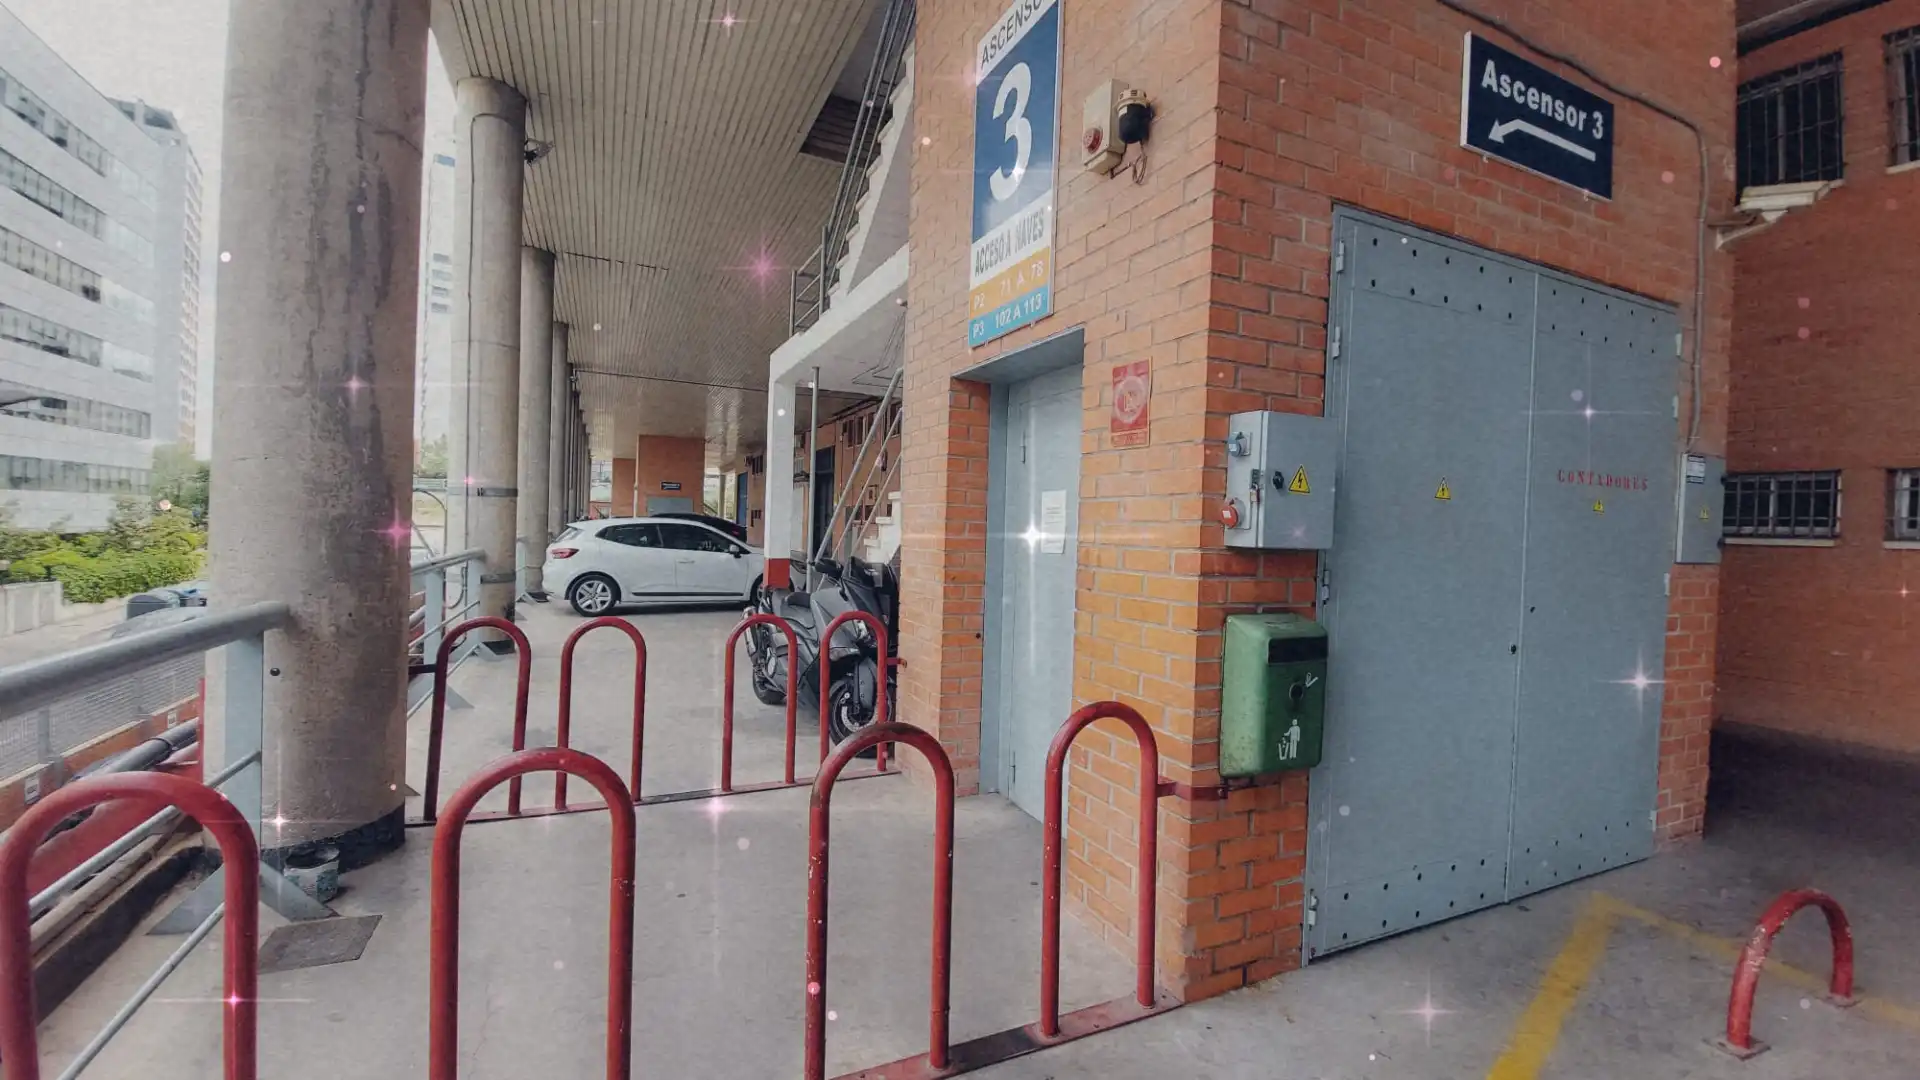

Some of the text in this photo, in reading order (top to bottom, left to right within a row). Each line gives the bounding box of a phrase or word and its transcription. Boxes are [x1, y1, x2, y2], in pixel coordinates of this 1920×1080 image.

[1481, 59, 1604, 140] Ascensor 3
[991, 62, 1032, 200] 3
[975, 208, 1044, 277] ACCESO A NAVES
[973, 293, 1042, 338] P3 102 A 113
[974, 293, 985, 309] P2
[1001, 279, 1011, 297] 71
[1016, 269, 1025, 286] A
[1557, 468, 1648, 491] CONTADORES
